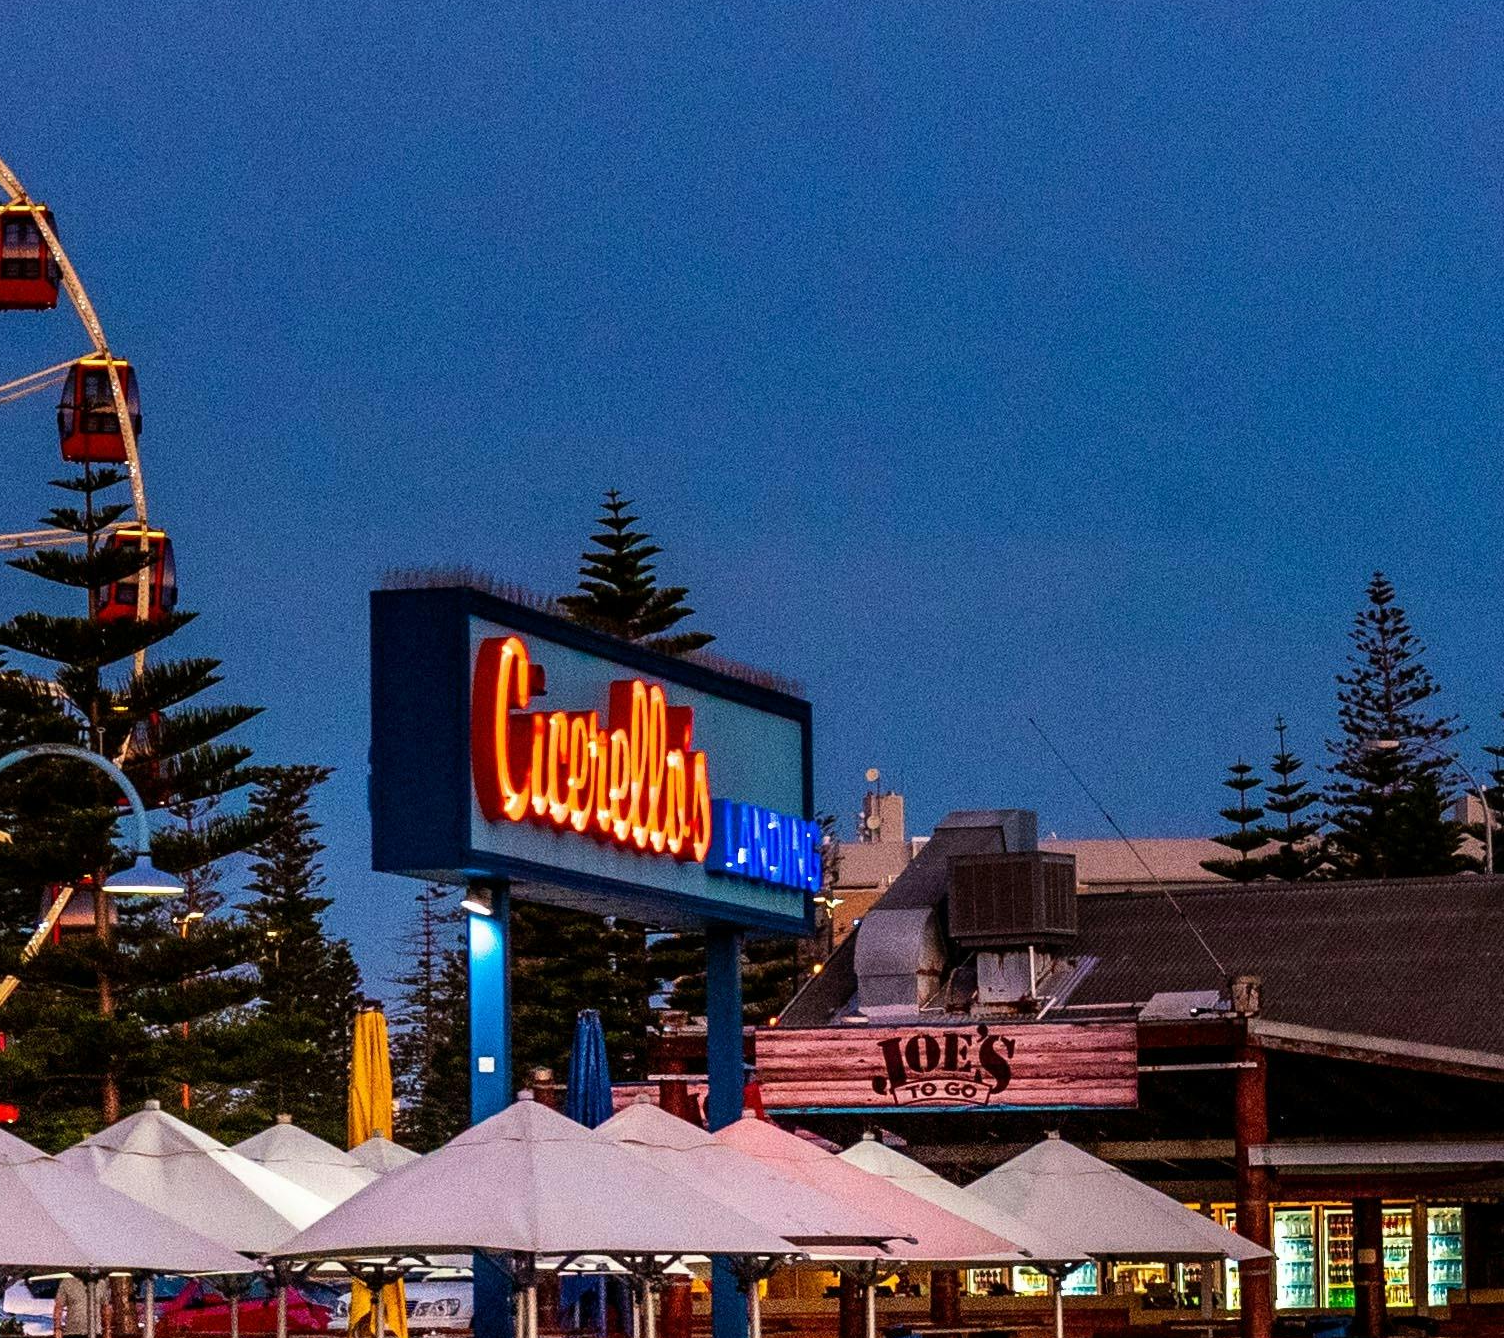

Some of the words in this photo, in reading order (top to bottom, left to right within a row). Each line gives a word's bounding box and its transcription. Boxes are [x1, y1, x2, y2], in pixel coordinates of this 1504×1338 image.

[473, 635, 711, 864] Cicerello's
[872, 1023, 1016, 1095] JOE'S
[905, 1082, 937, 1099] TO
[944, 1082, 977, 1099] GO
